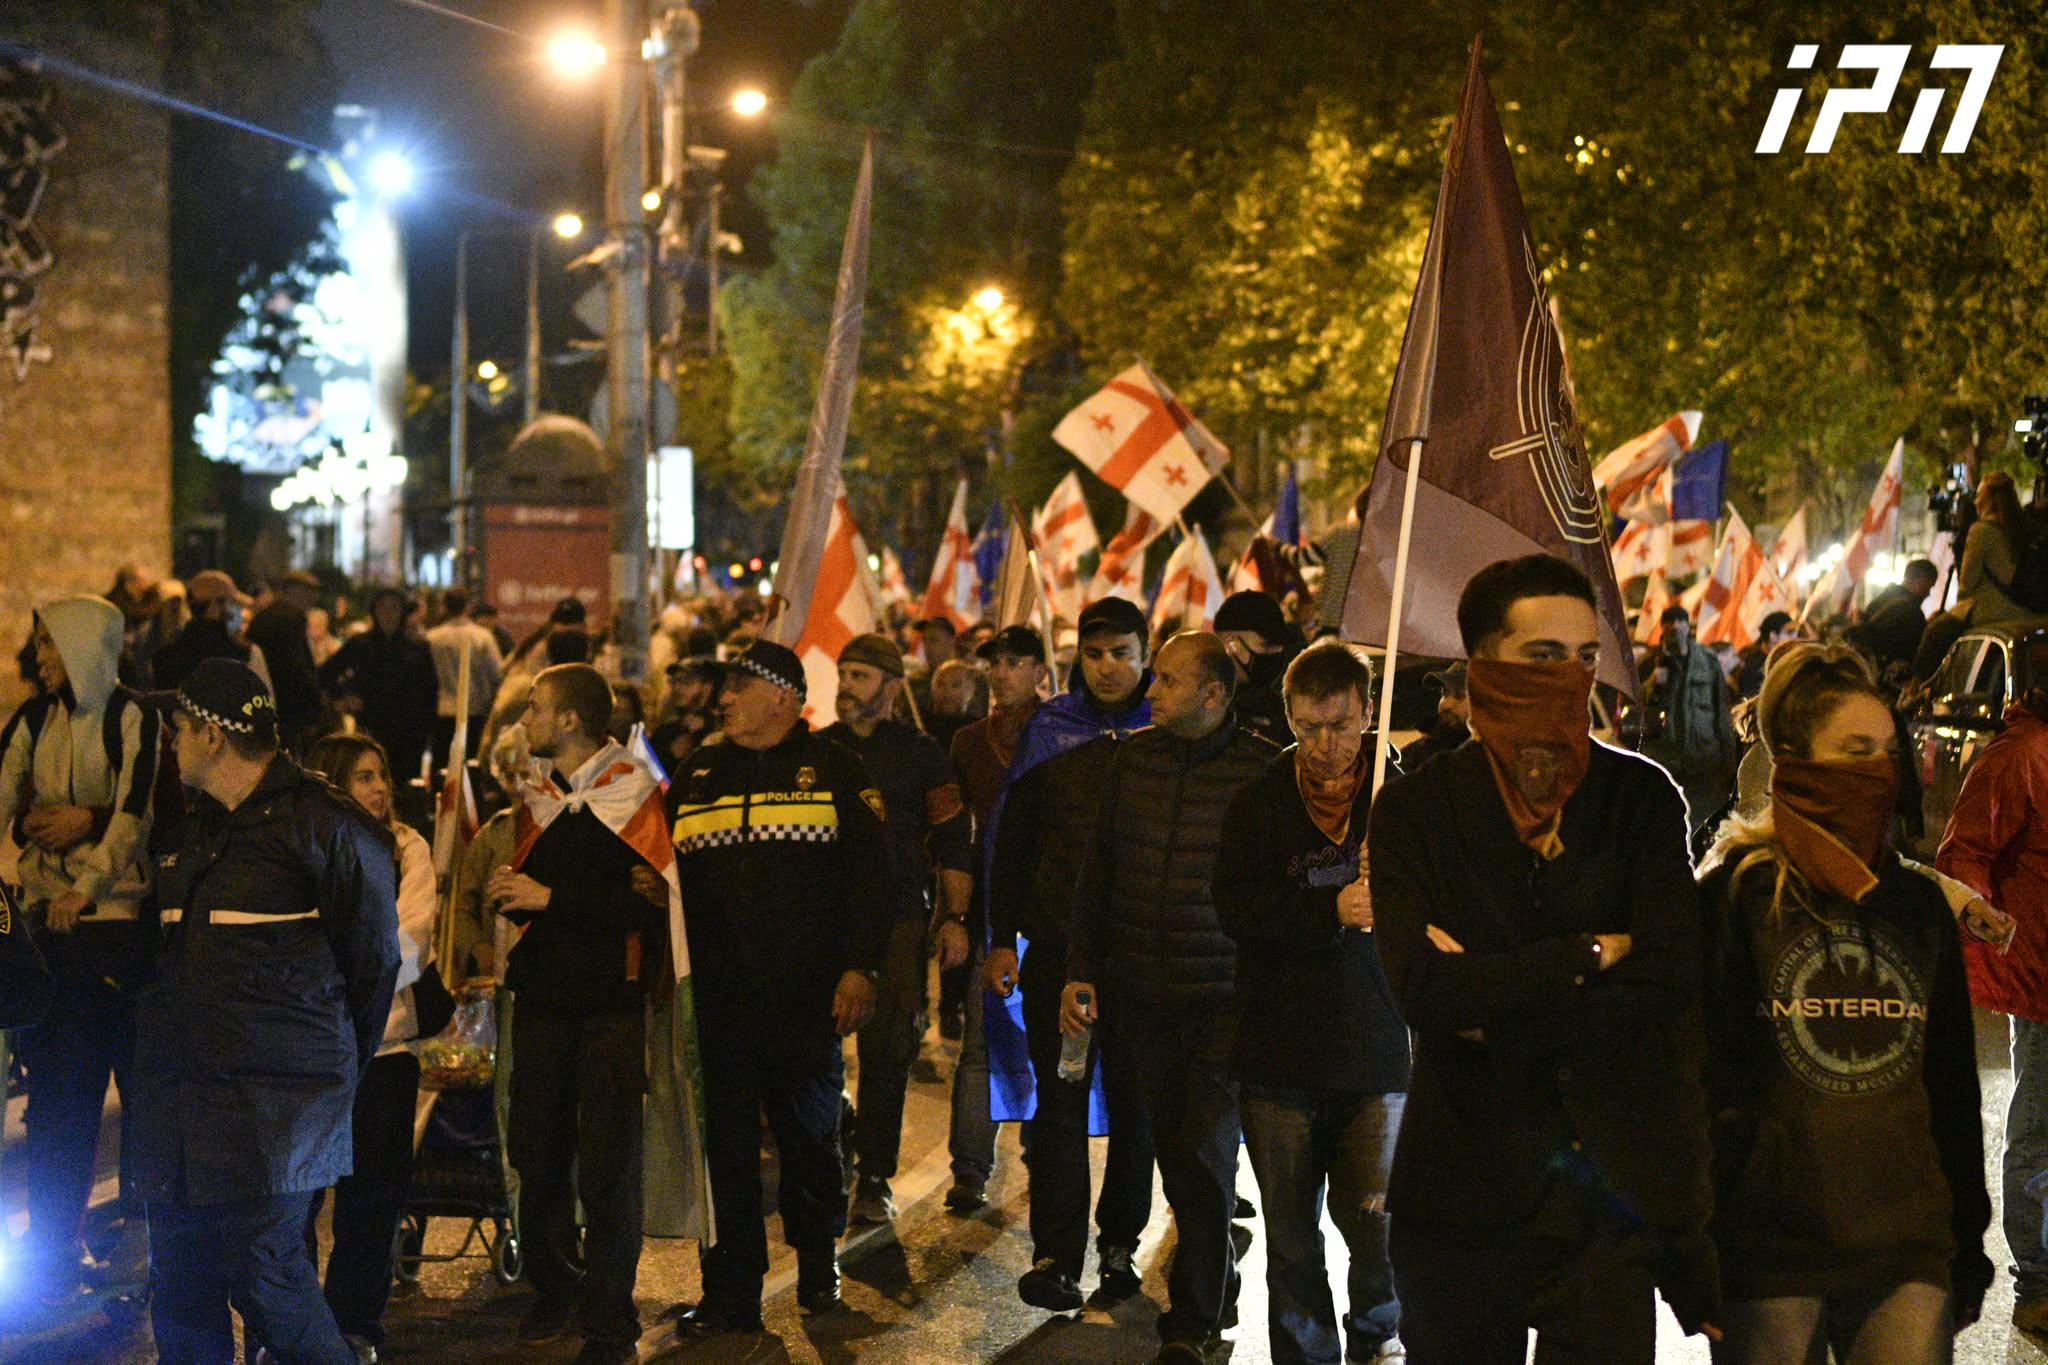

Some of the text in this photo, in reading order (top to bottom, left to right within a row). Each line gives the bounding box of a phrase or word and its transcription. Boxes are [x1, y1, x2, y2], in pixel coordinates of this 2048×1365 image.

[767, 791, 812, 801] POLICE
[1773, 945, 1804, 993] CAPITAL
[1802, 931, 1821, 948] OF
